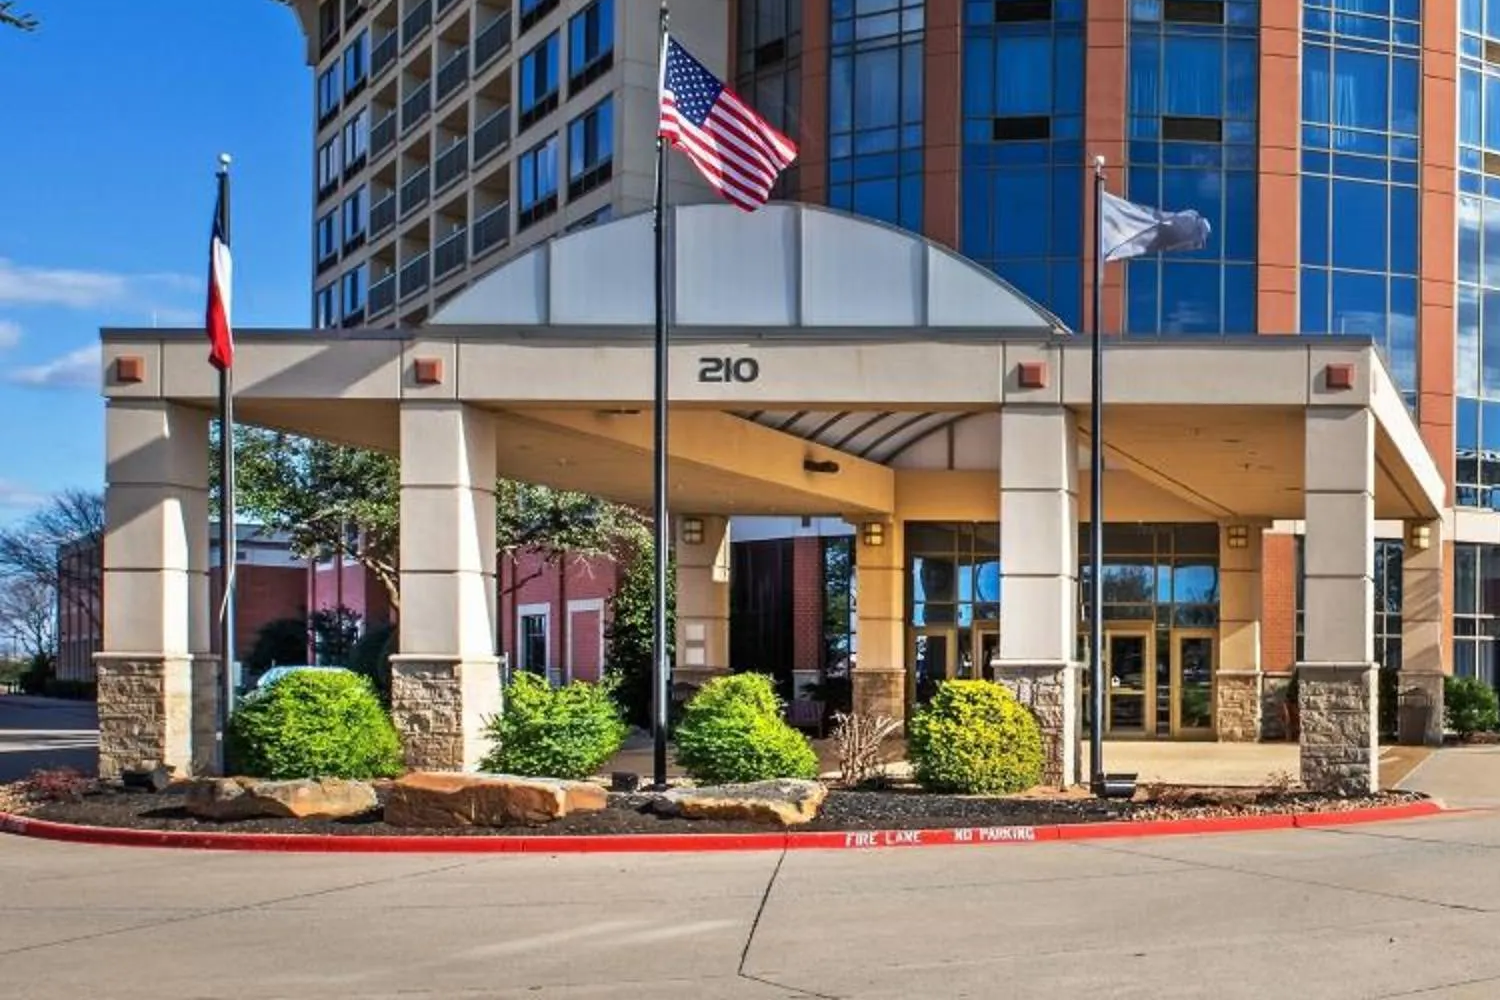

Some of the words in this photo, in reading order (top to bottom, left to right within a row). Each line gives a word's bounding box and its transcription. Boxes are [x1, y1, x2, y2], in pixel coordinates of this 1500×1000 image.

[698, 357, 759, 383] 210
[845, 831, 876, 846] FIRE
[885, 830, 922, 845] LANE
[954, 828, 973, 841] NO
[979, 827, 1035, 840] PARKING
